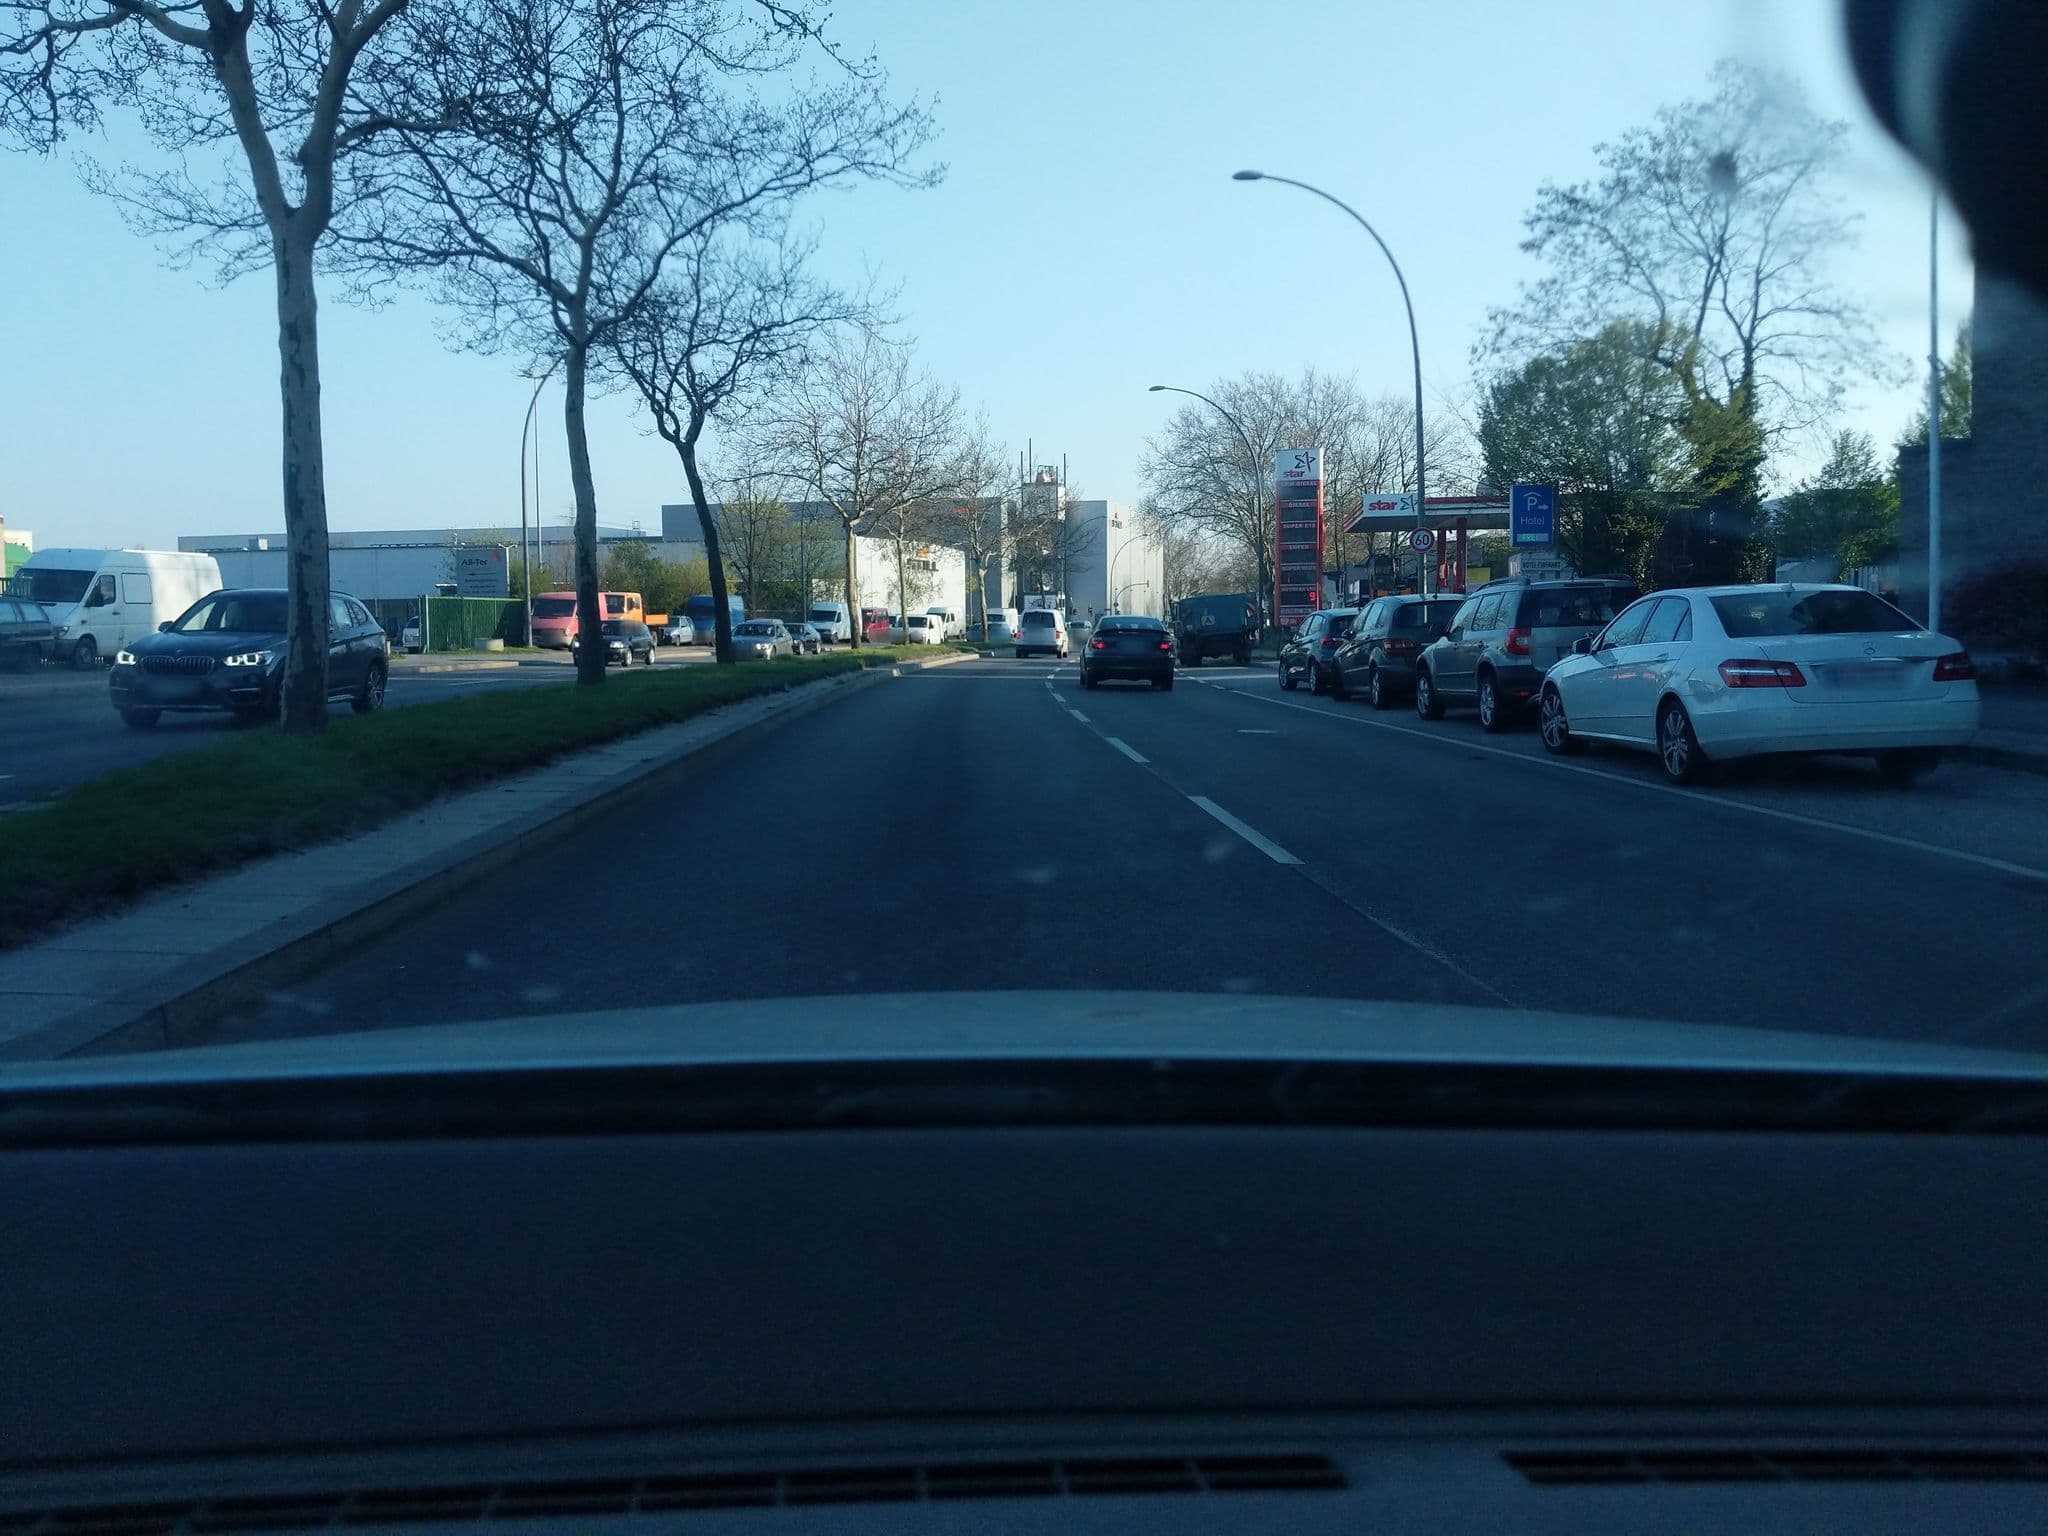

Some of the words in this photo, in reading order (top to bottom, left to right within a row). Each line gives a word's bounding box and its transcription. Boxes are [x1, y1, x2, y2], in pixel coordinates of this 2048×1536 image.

[1283, 469, 1305, 478] star
[1368, 500, 1398, 511] star
[1527, 496, 1538, 511] P
[1520, 516, 1545, 525] Hotel
[1415, 534, 1430, 546] 60
[1309, 591, 1316, 601] 9
